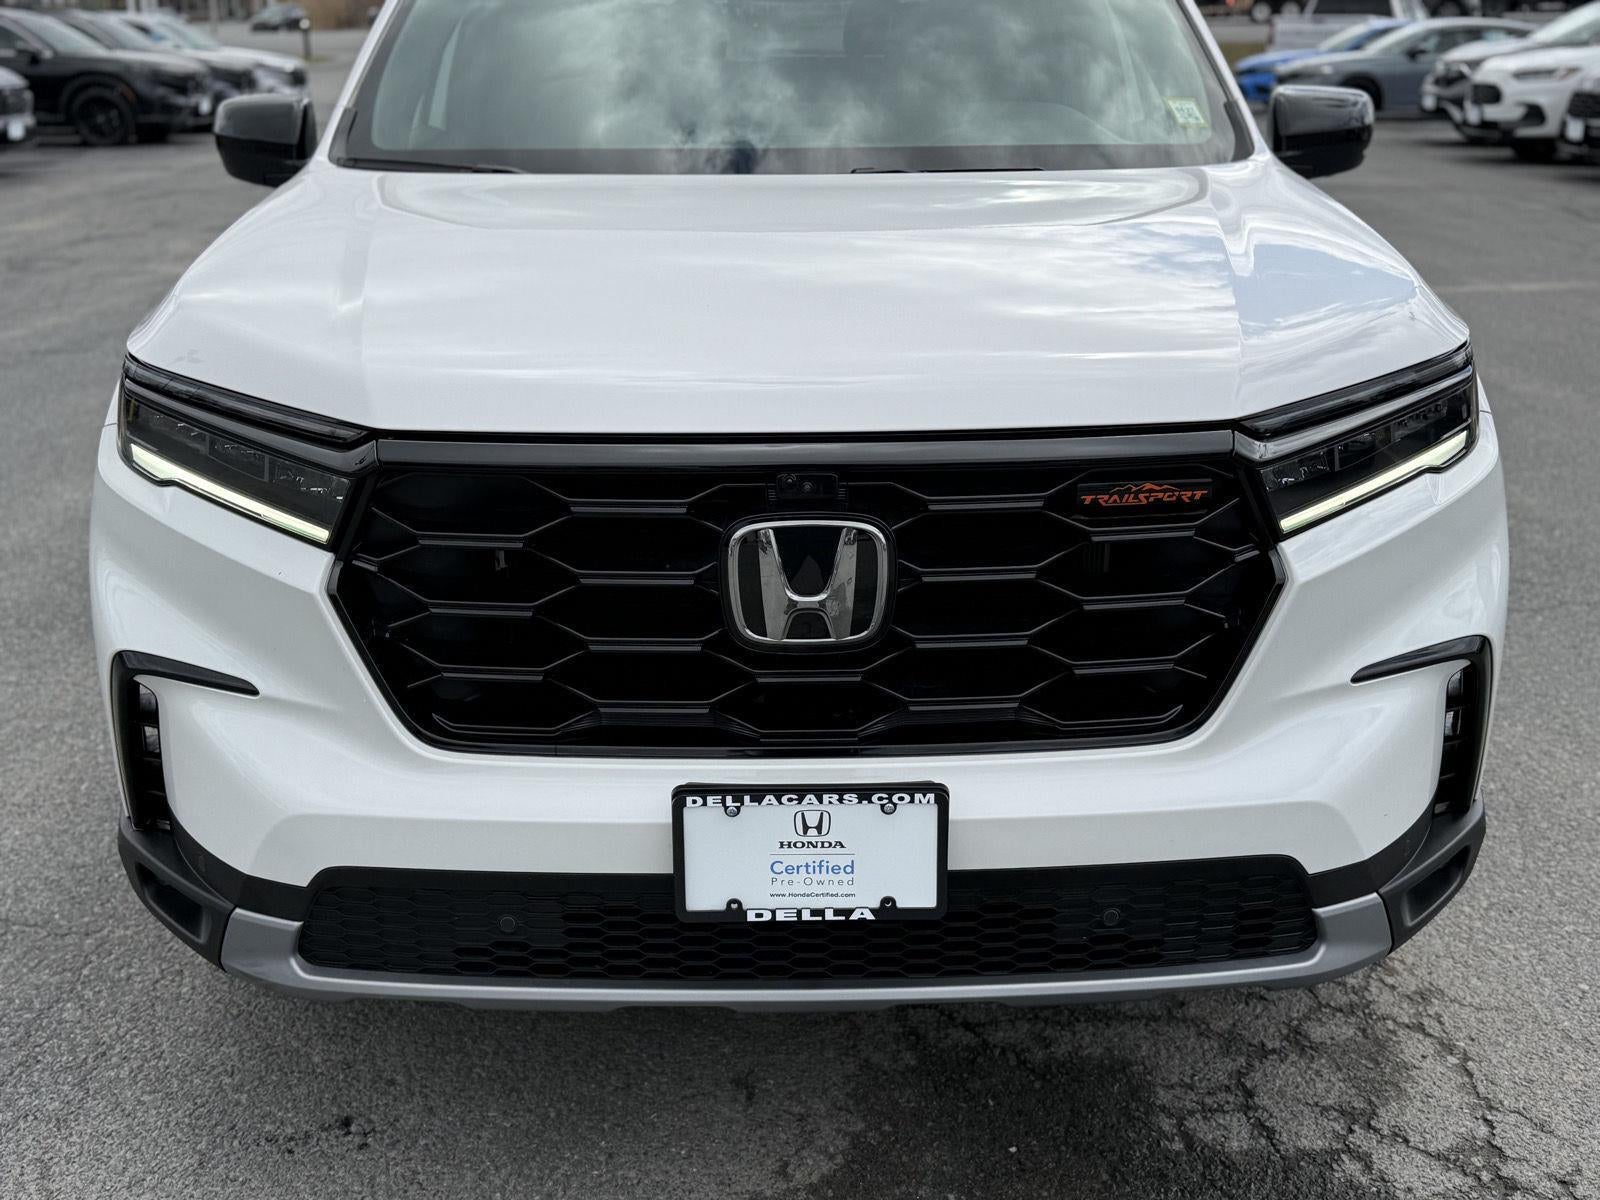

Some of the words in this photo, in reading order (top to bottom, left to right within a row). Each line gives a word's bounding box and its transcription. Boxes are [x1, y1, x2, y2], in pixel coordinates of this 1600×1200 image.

[1080, 491, 1208, 506] TRAILSPORT
[686, 793, 935, 808] DELLACARS.COM
[778, 840, 847, 849] HONDA
[770, 859, 855, 875] Certified
[771, 877, 854, 886] Pre-Owned
[747, 907, 876, 922] DELLA
